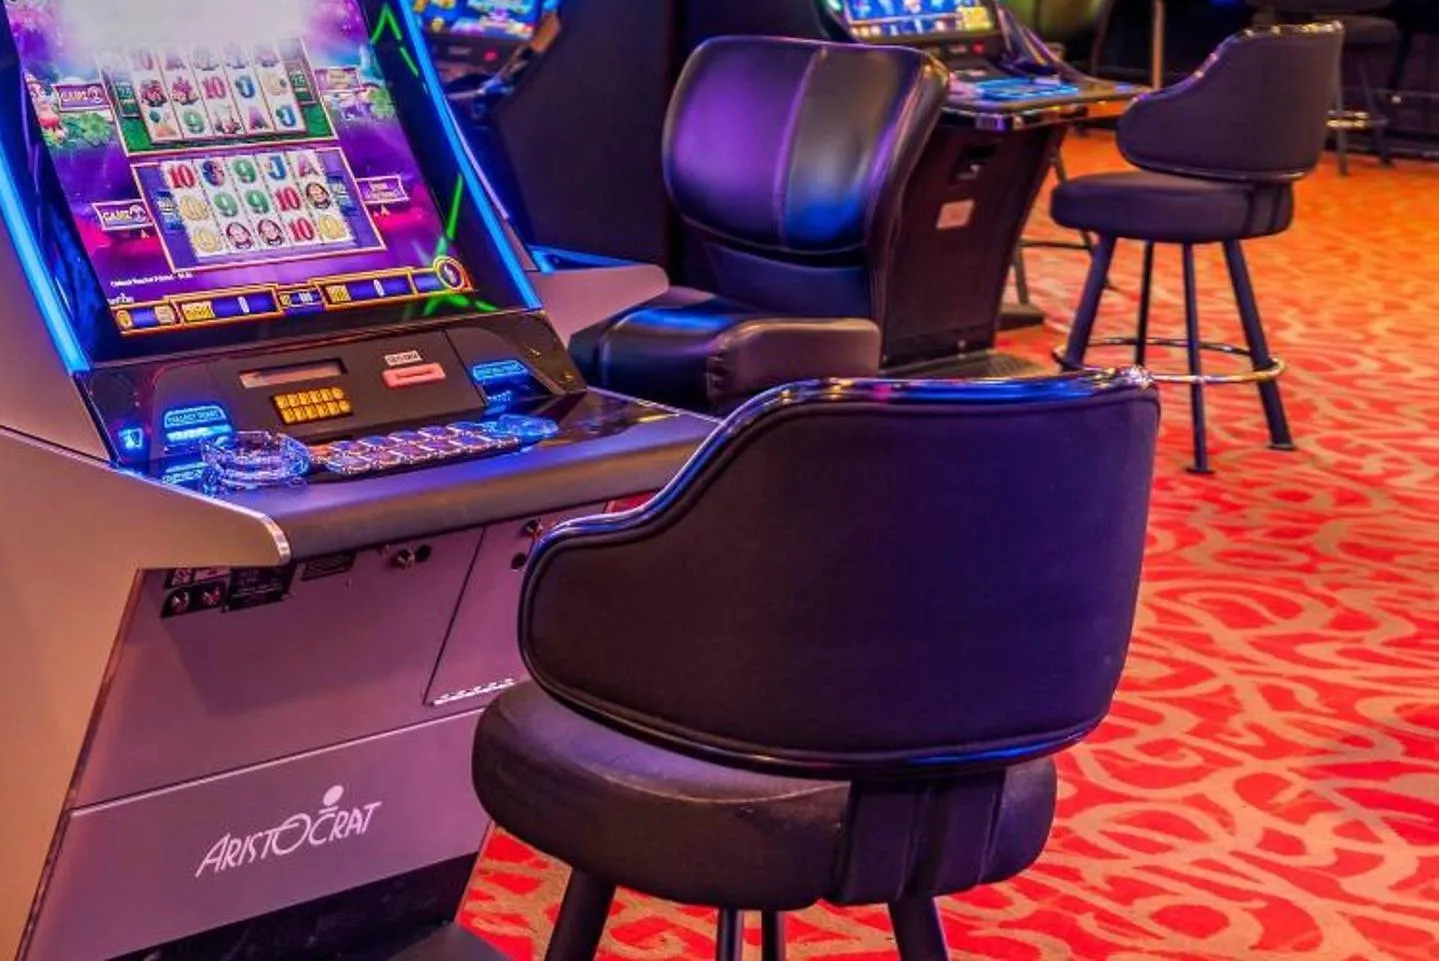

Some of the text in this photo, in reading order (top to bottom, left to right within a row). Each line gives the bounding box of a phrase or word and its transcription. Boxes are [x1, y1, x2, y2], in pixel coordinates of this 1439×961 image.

[202, 76, 227, 100] 10
[275, 104, 297, 128] J
[168, 164, 196, 189] 10
[232, 158, 257, 184] 9
[262, 155, 288, 181] J
[297, 152, 321, 178] A
[212, 192, 239, 218] 9
[245, 189, 271, 215] 9
[275, 186, 301, 212] 10
[288, 216, 315, 242] 10
[195, 785, 383, 878] ARISTOCRAT
